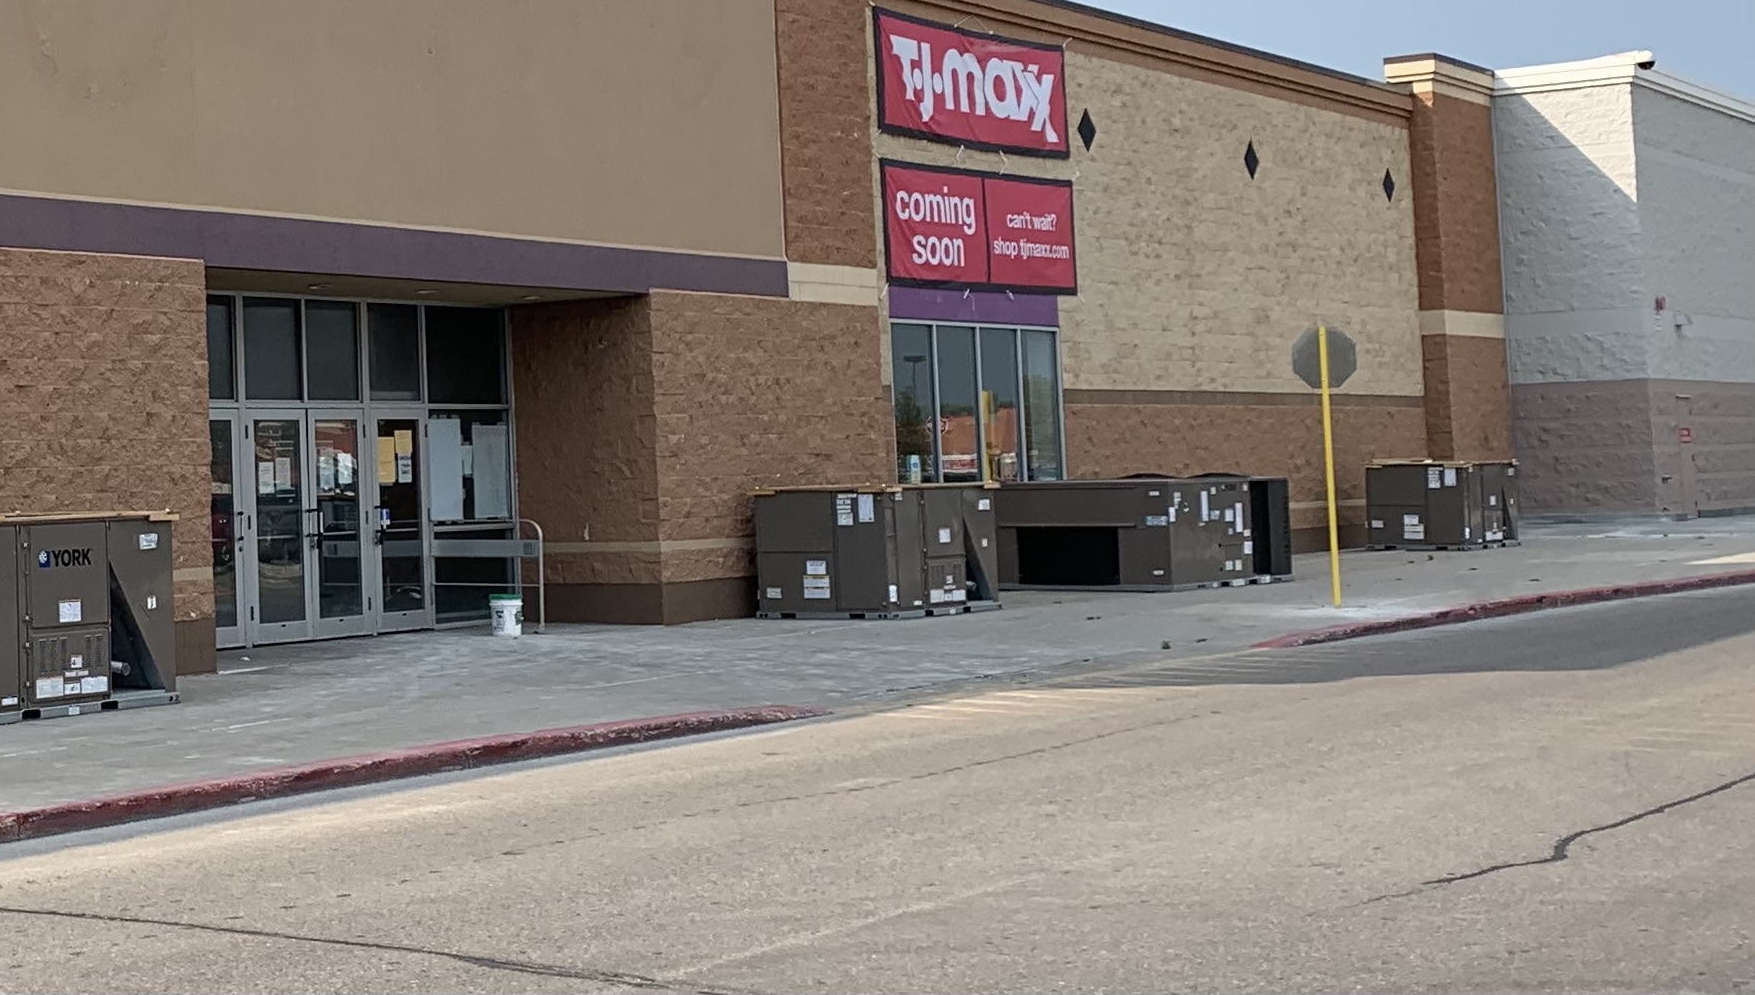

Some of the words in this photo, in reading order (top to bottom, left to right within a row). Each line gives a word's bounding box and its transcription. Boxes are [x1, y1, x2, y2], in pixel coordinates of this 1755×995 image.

[896, 186, 976, 235] coming
[1006, 211, 1032, 230] can't
[1032, 213, 1057, 232] wait?
[912, 235, 965, 267] soon
[993, 236, 1018, 259] shop
[1019, 238, 1070, 260] tjmaxx.com
[51, 548, 92, 567] YORK
